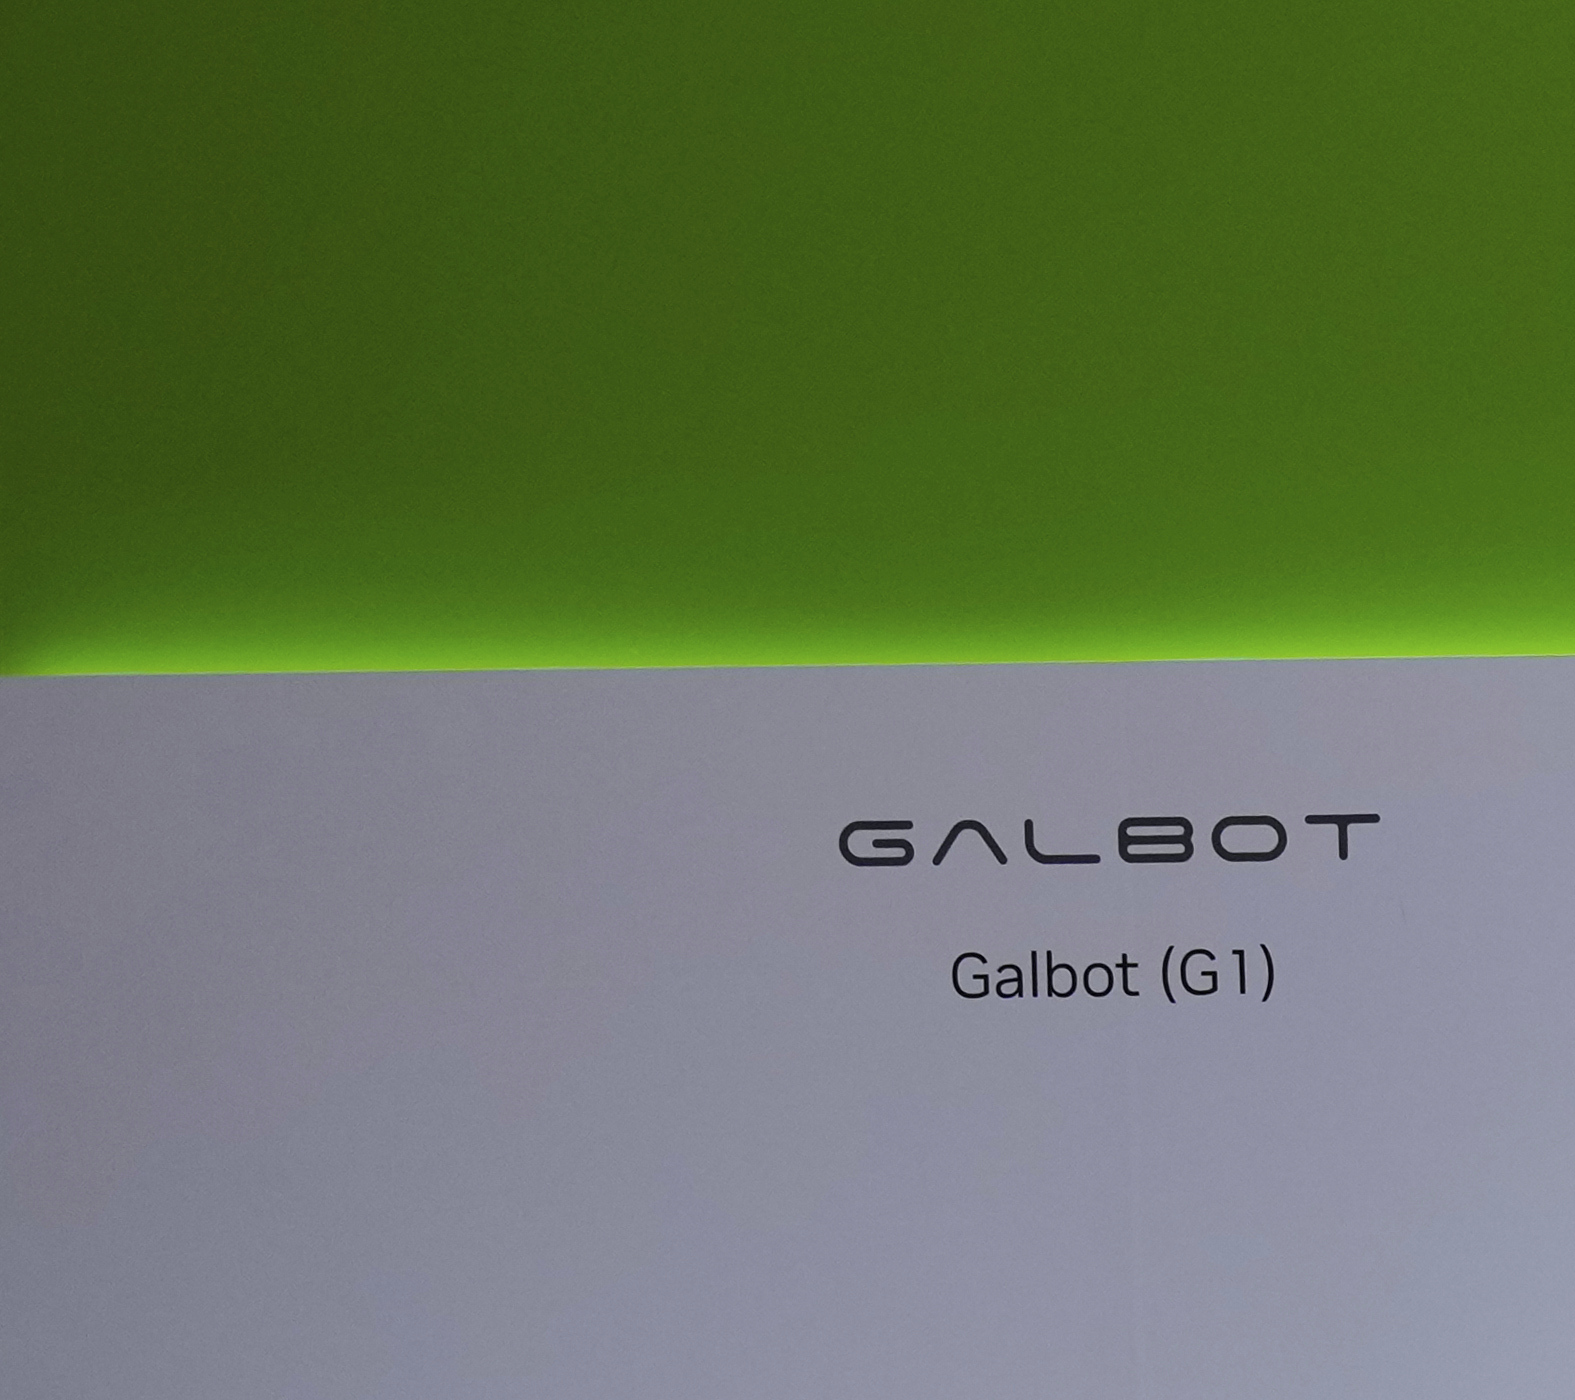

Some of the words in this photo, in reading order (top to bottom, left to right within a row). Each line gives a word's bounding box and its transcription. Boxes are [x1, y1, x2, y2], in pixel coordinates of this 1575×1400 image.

[839, 814, 1382, 869] GALBOT
[952, 950, 1141, 1001] Galbot
[1162, 944, 1276, 1005] (G1)
